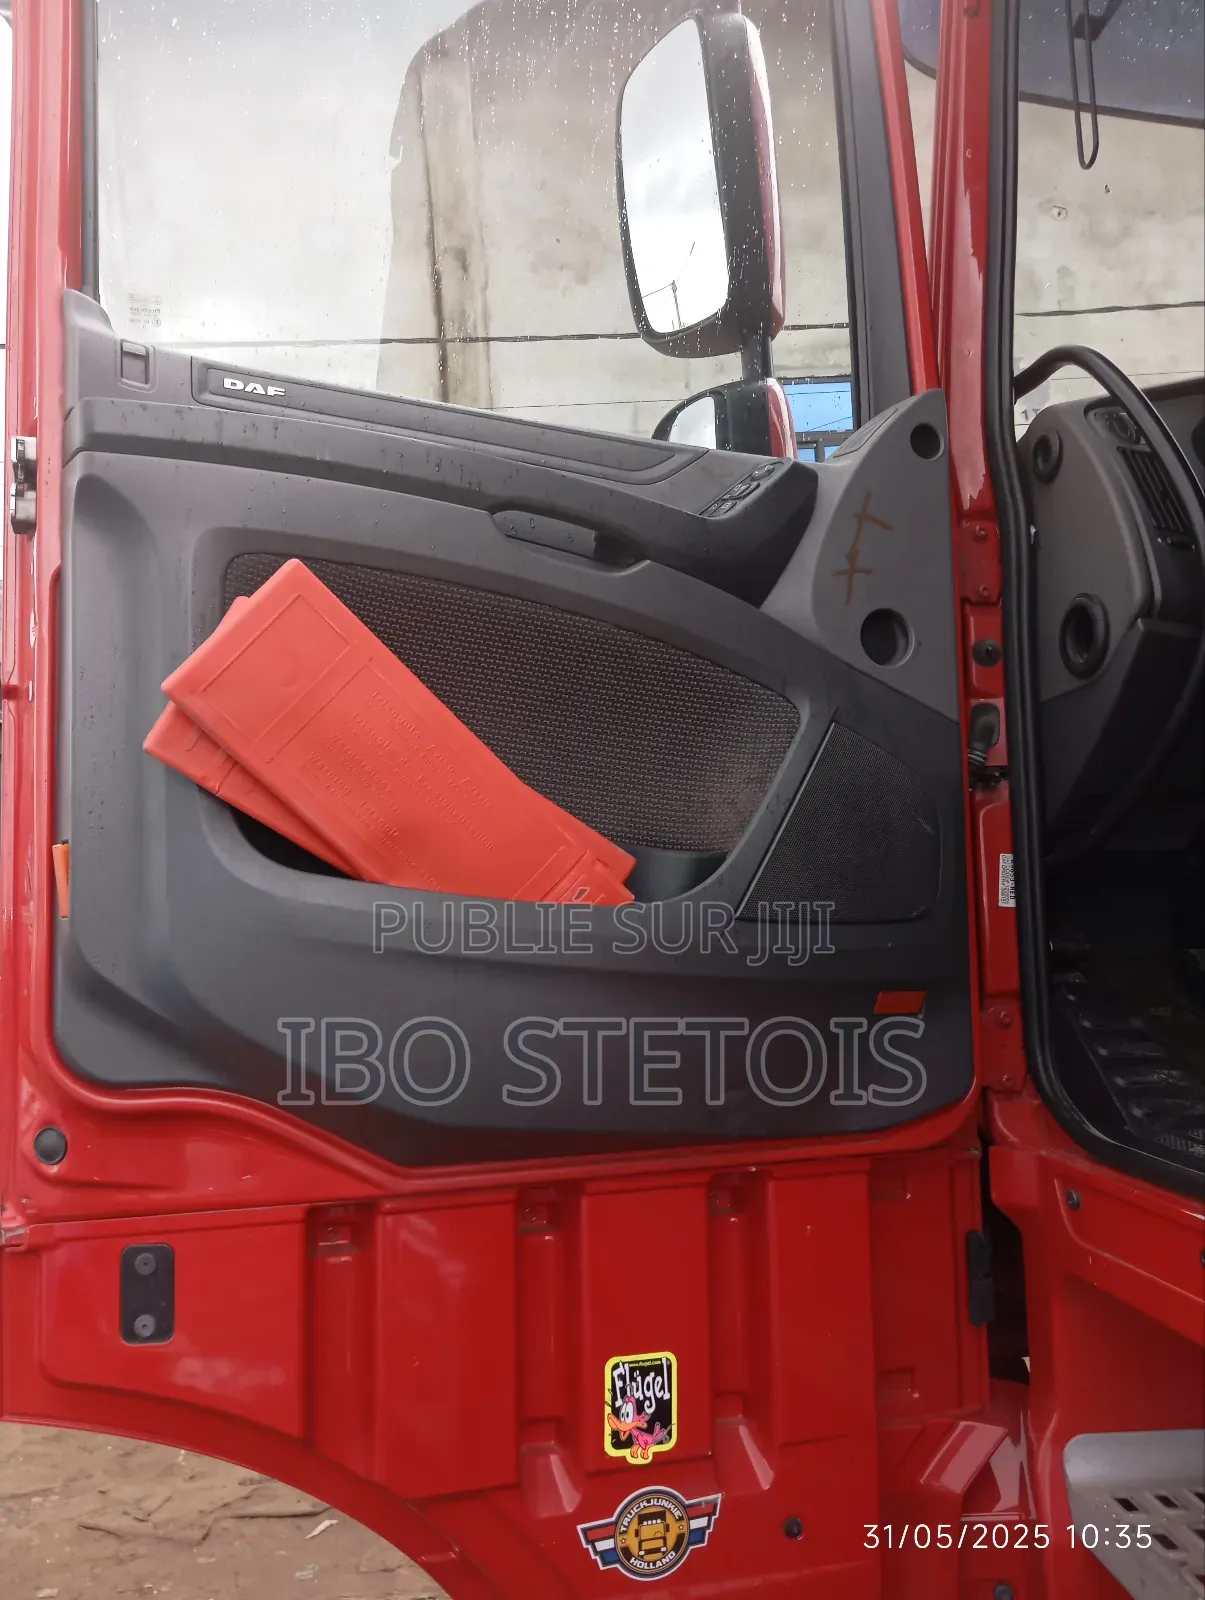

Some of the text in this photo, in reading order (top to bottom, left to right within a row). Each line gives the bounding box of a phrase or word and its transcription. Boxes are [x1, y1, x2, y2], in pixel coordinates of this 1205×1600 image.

[223, 378, 286, 397] DAF
[613, 1357, 670, 1414] Flügel
[620, 1498, 682, 1532] TRUCKJUNKIE
[629, 1551, 676, 1569] HOLLAND
